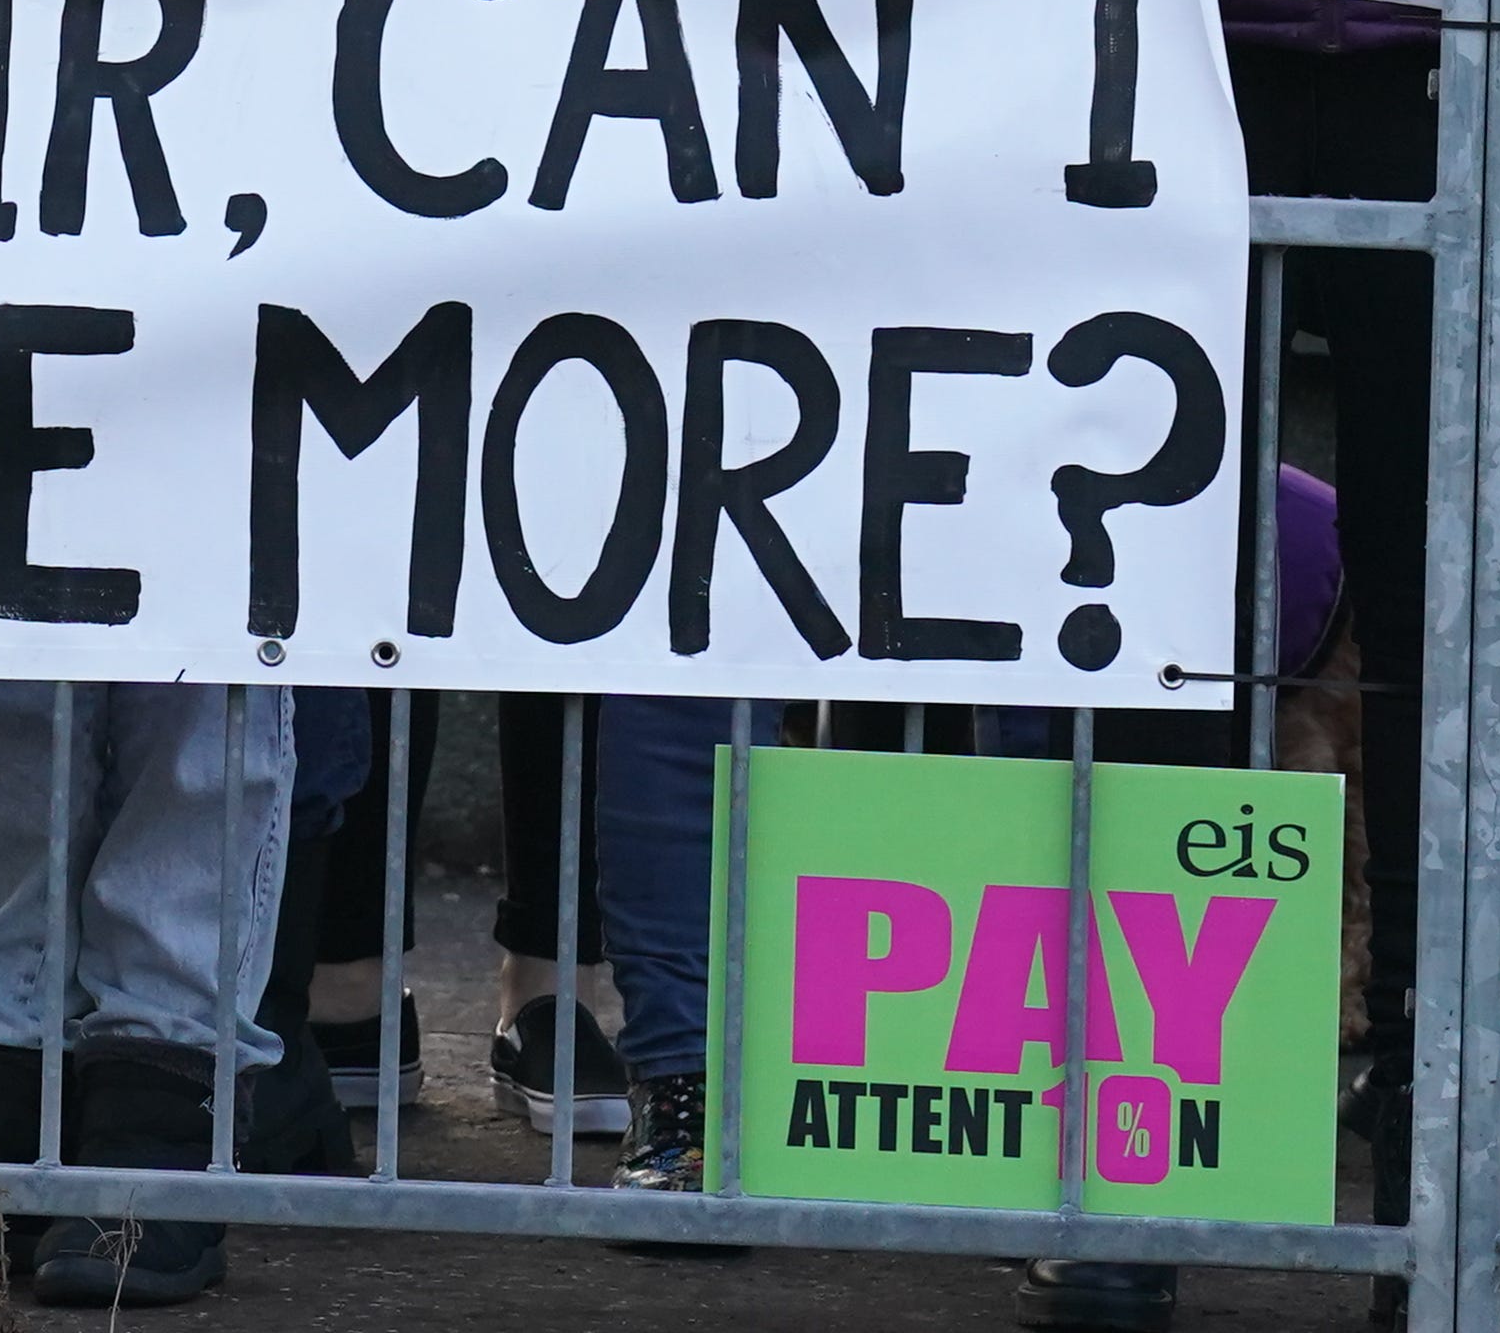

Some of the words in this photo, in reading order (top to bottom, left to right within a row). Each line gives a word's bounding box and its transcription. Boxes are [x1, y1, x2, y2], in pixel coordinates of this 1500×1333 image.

[248, 299, 1227, 672] MORE?
[1177, 804, 1310, 882] eis
[791, 874, 1279, 1085] PAY
